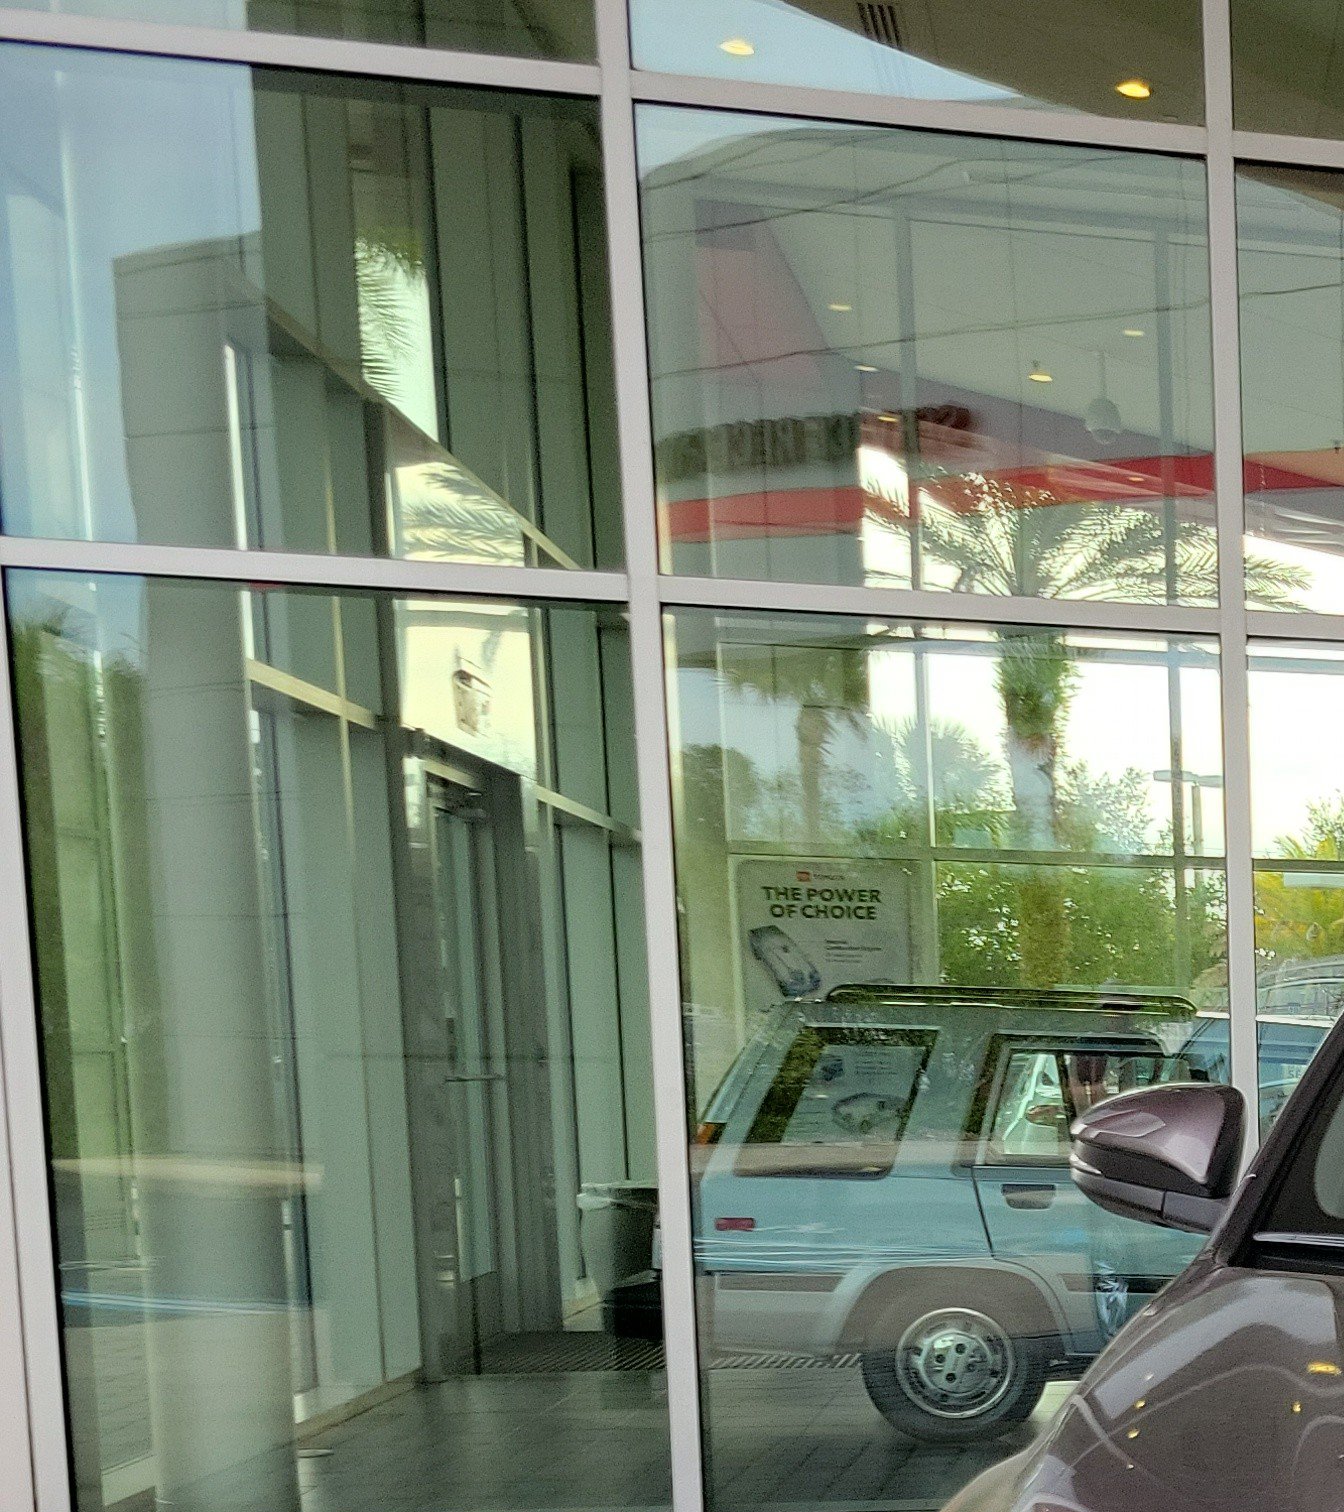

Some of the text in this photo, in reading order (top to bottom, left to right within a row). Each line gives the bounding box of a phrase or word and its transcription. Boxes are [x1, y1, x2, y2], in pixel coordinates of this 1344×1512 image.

[761, 886, 882, 903] THE POWER
[770, 904, 878, 920] OF CHOICE
